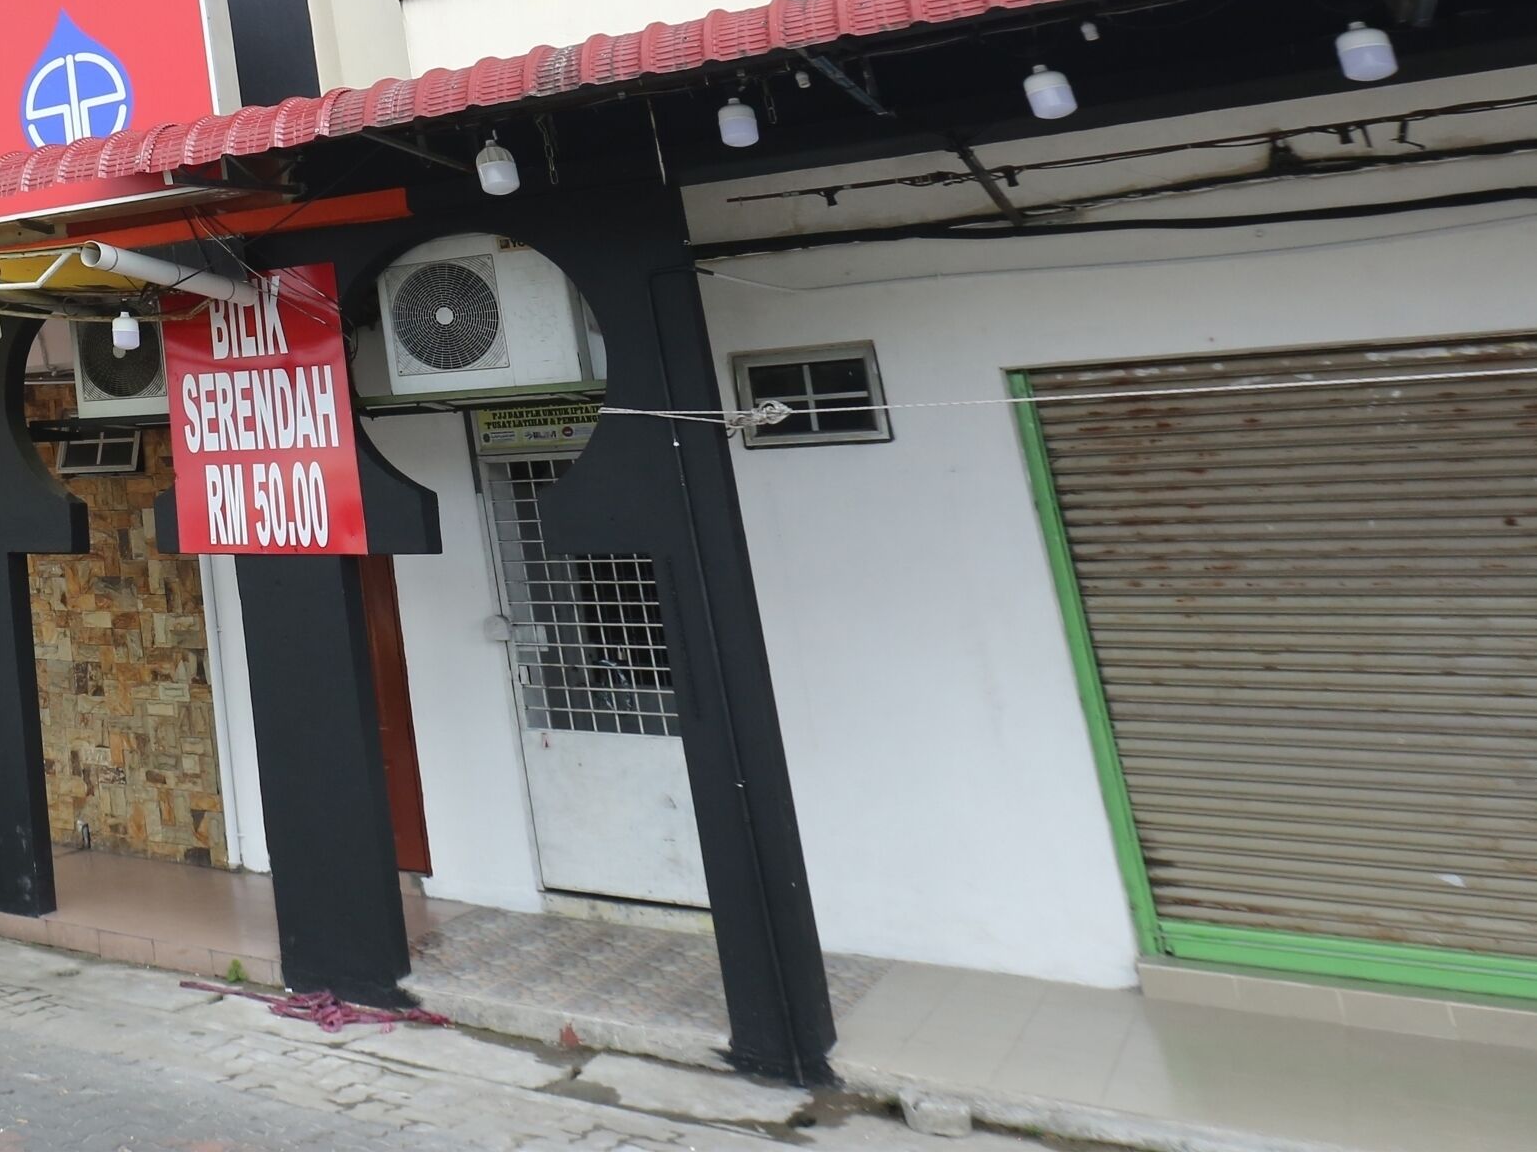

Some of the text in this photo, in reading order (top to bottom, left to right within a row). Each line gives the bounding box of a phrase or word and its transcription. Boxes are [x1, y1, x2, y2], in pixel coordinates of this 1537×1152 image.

[209, 275, 289, 361] BILIK
[182, 364, 340, 455] SERENDAH
[557, 414, 600, 425] PEMBANG
[204, 461, 330, 549] RM 50.00
